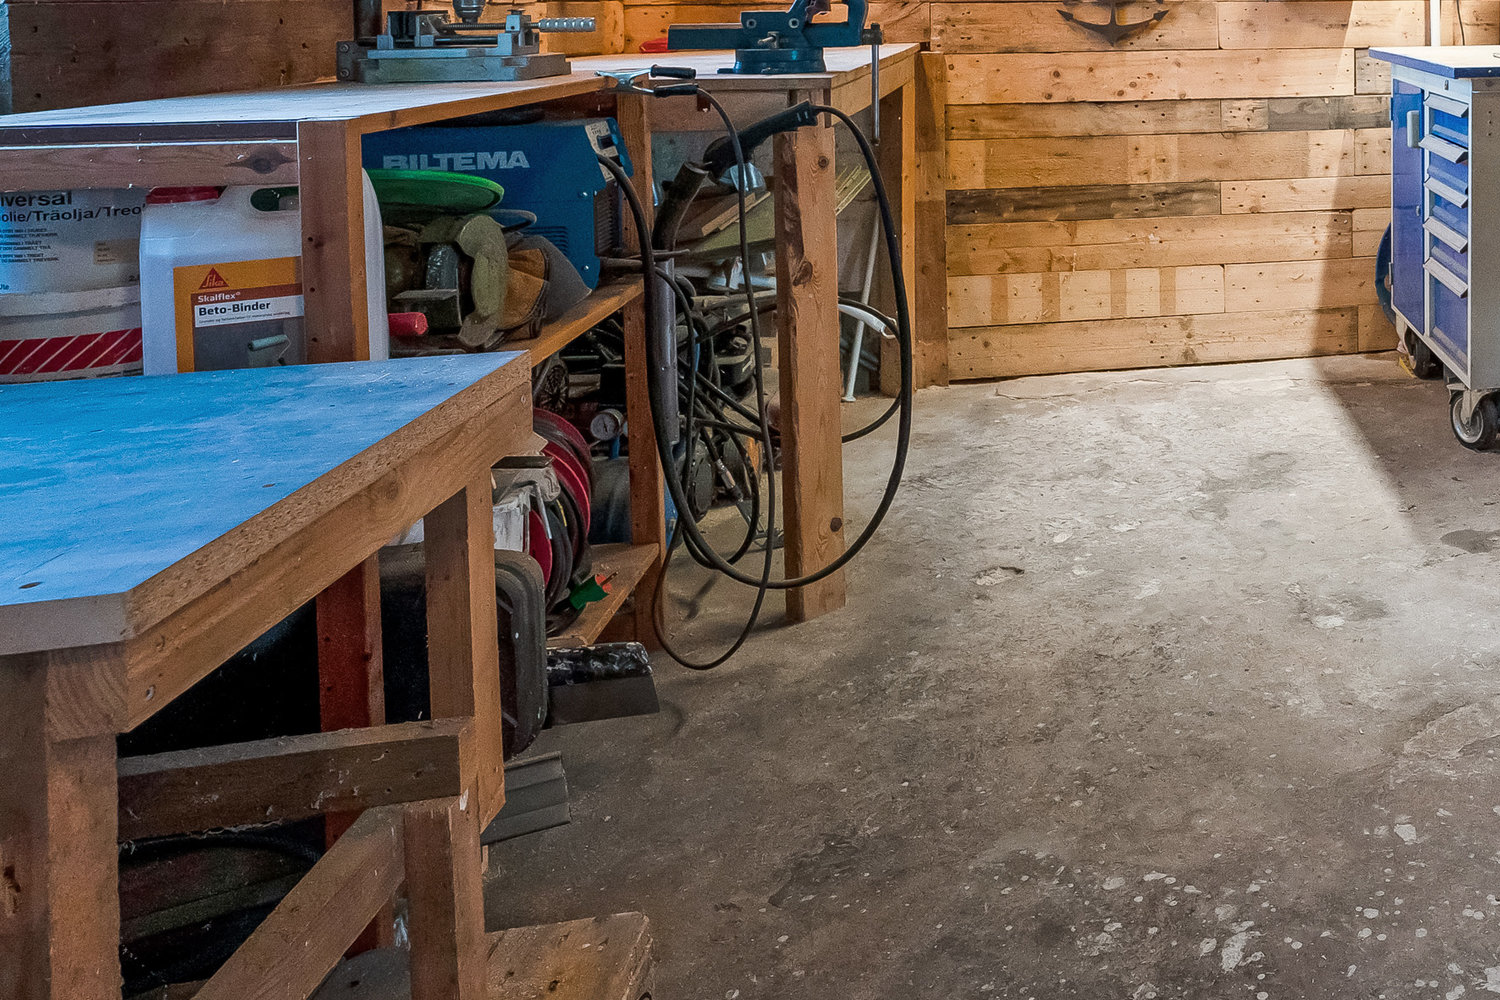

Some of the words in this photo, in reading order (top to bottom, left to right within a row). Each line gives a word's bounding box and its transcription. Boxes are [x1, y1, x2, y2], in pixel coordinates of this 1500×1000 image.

[383, 150, 530, 171] BILTEMA
[202, 273, 225, 288] Sika
[199, 302, 271, 316] Beto-Binder
